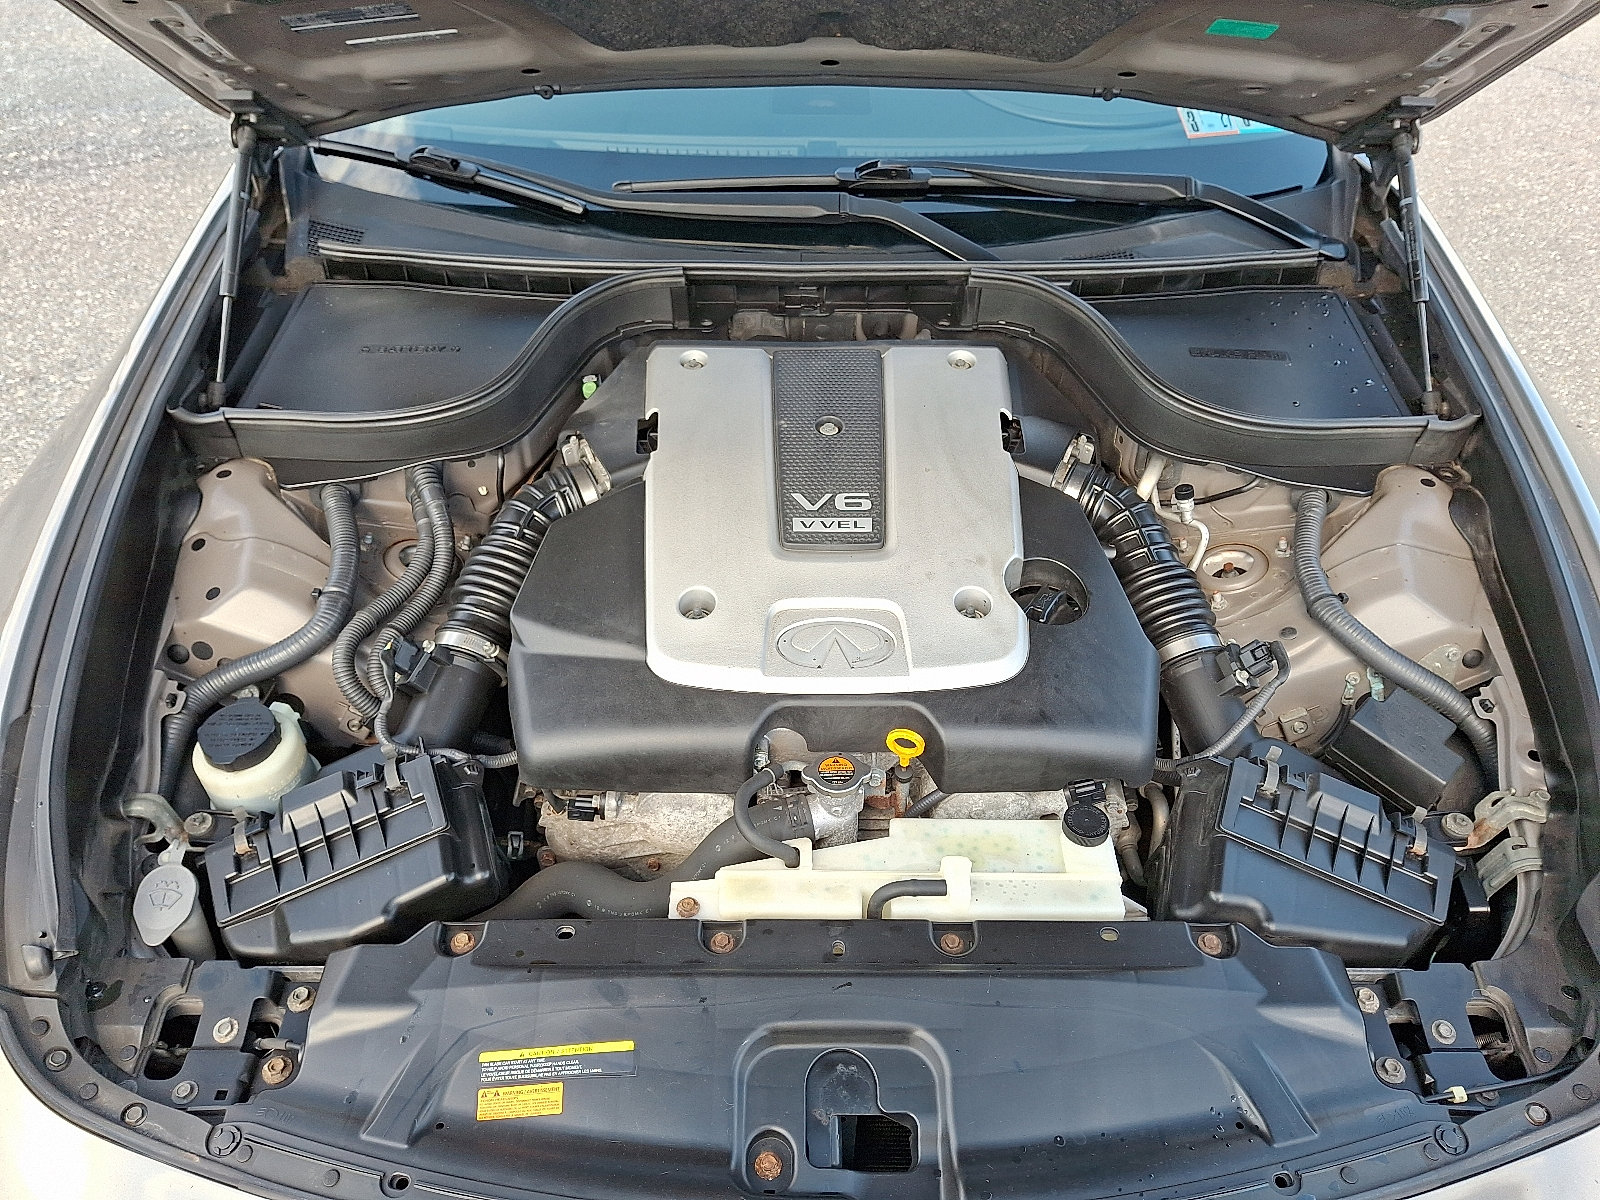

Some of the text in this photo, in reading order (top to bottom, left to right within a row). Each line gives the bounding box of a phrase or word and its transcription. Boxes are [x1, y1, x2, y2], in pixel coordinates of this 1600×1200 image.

[1186, 110, 1200, 132] 3
[790, 492, 873, 511] V6
[798, 520, 867, 530] VVEL
